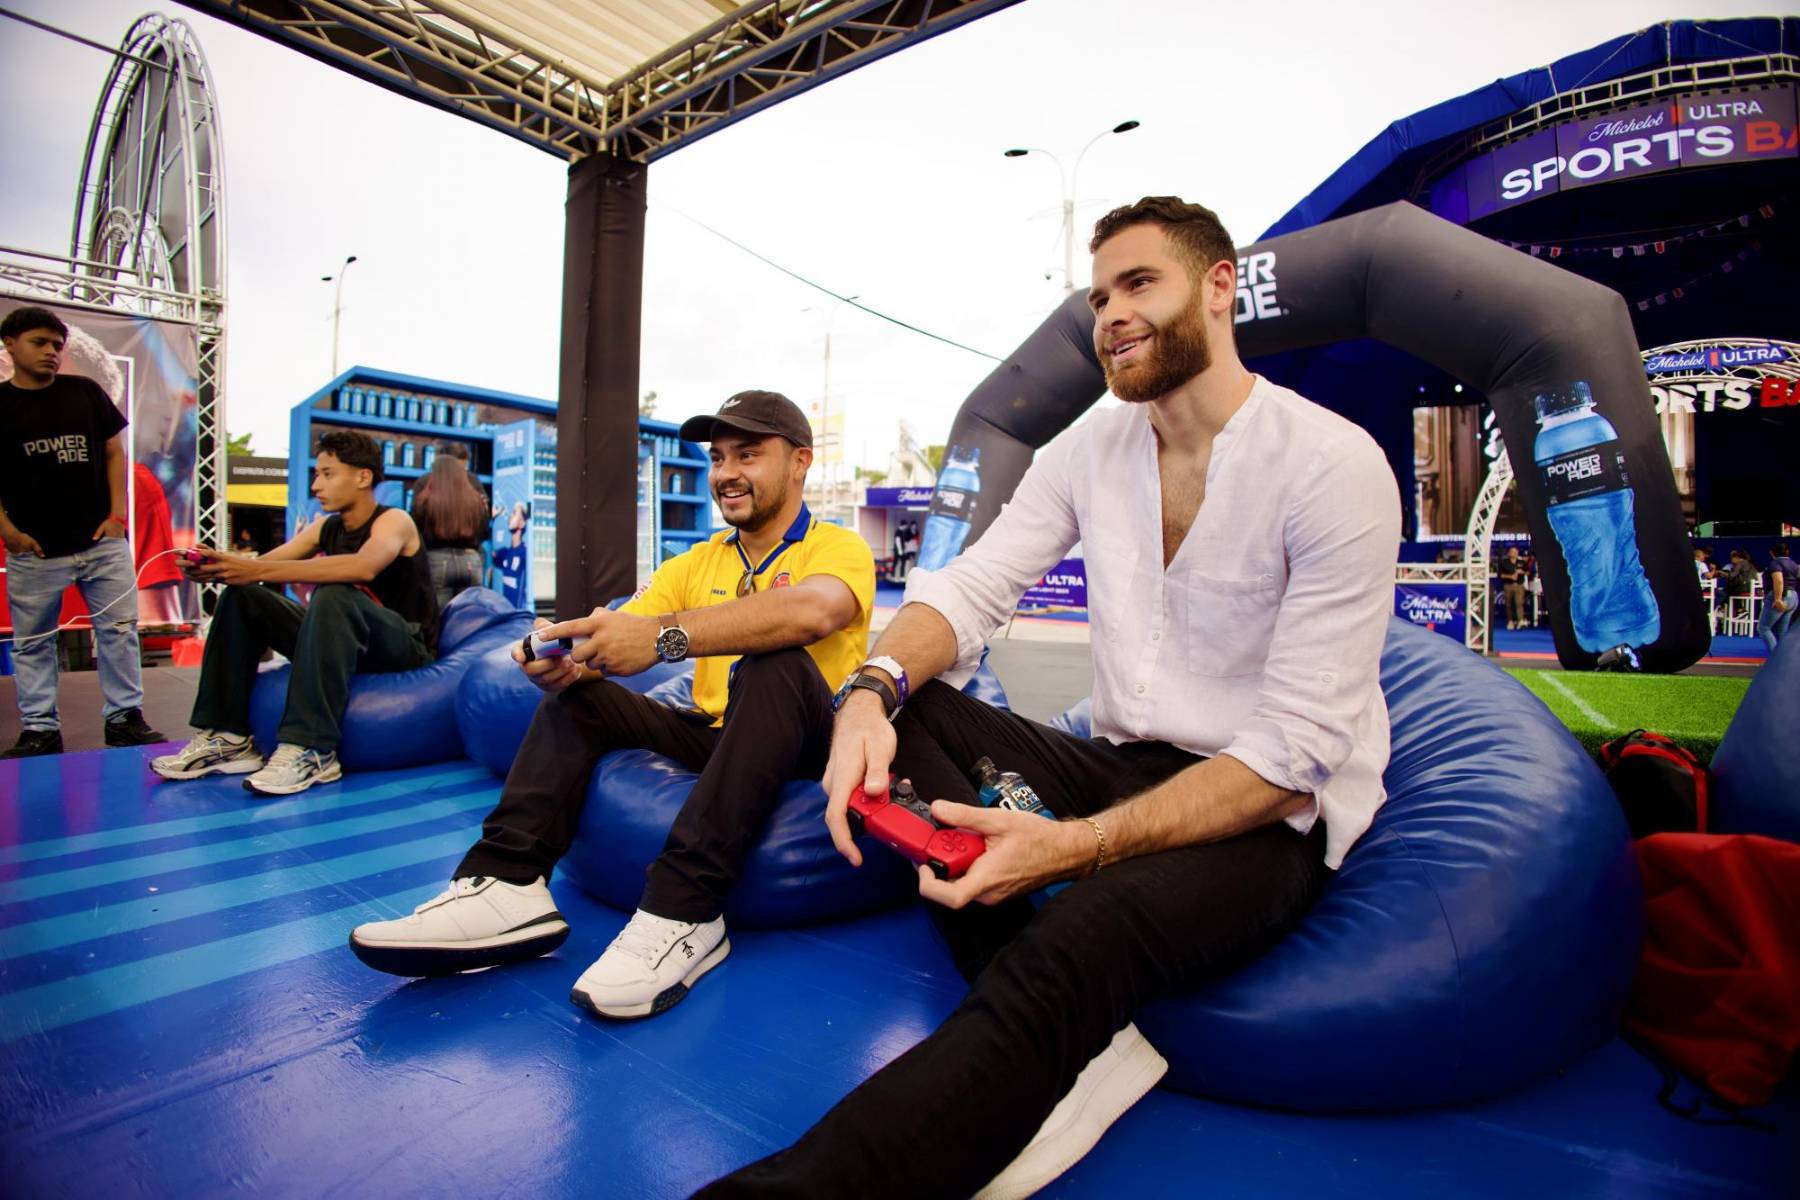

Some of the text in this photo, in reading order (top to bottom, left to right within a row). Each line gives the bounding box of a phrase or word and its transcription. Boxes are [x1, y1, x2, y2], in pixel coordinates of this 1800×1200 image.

[1589, 100, 1763, 142] Michelob ULTRA
[1501, 125, 1735, 200] SPORTS
[1649, 347, 1782, 371] Michelob ULTRA
[23, 434, 87, 456] POWER
[57, 448, 89, 464] ADE
[1547, 454, 1600, 478] POWER
[1567, 464, 1602, 482] ADE
[1045, 574, 1085, 587] ULTRA
[1409, 609, 1453, 621] ULTRA
